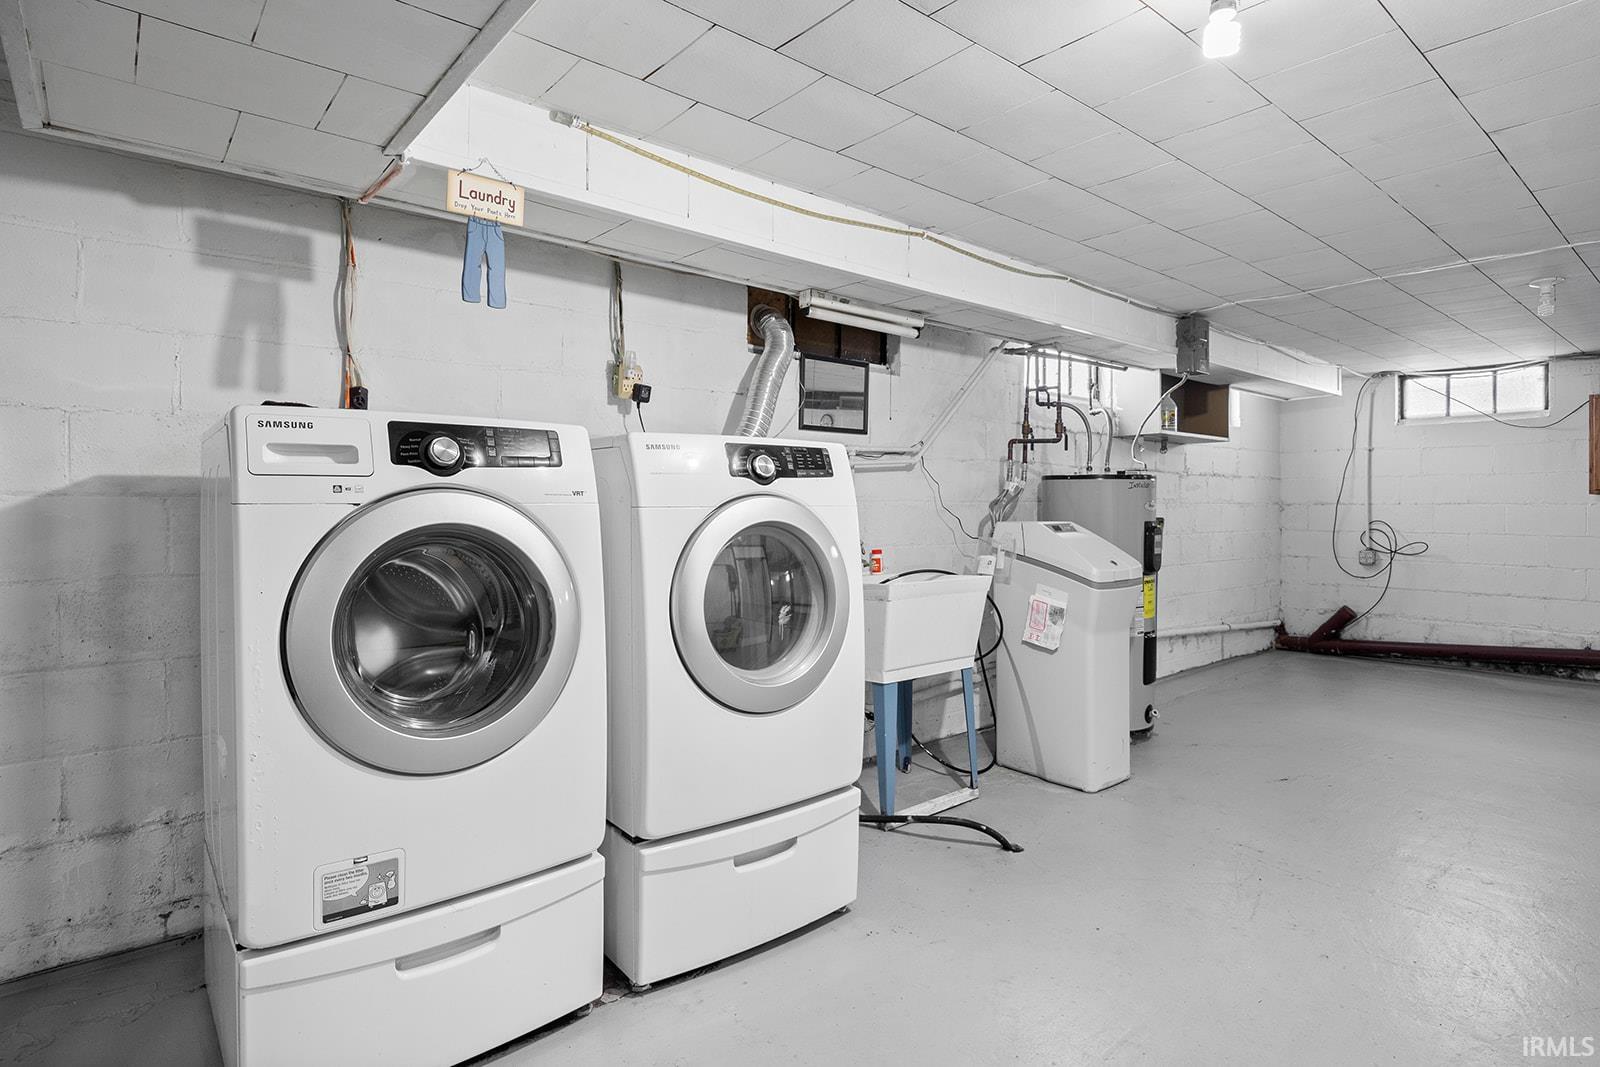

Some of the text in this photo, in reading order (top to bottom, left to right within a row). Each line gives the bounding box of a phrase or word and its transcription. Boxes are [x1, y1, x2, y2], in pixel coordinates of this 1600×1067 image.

[459, 180, 516, 213] Laundry
[454, 201, 467, 210] Drop
[471, 203, 483, 212] Your
[487, 208, 502, 217] Pants
[257, 420, 314, 429] SAMSUNG
